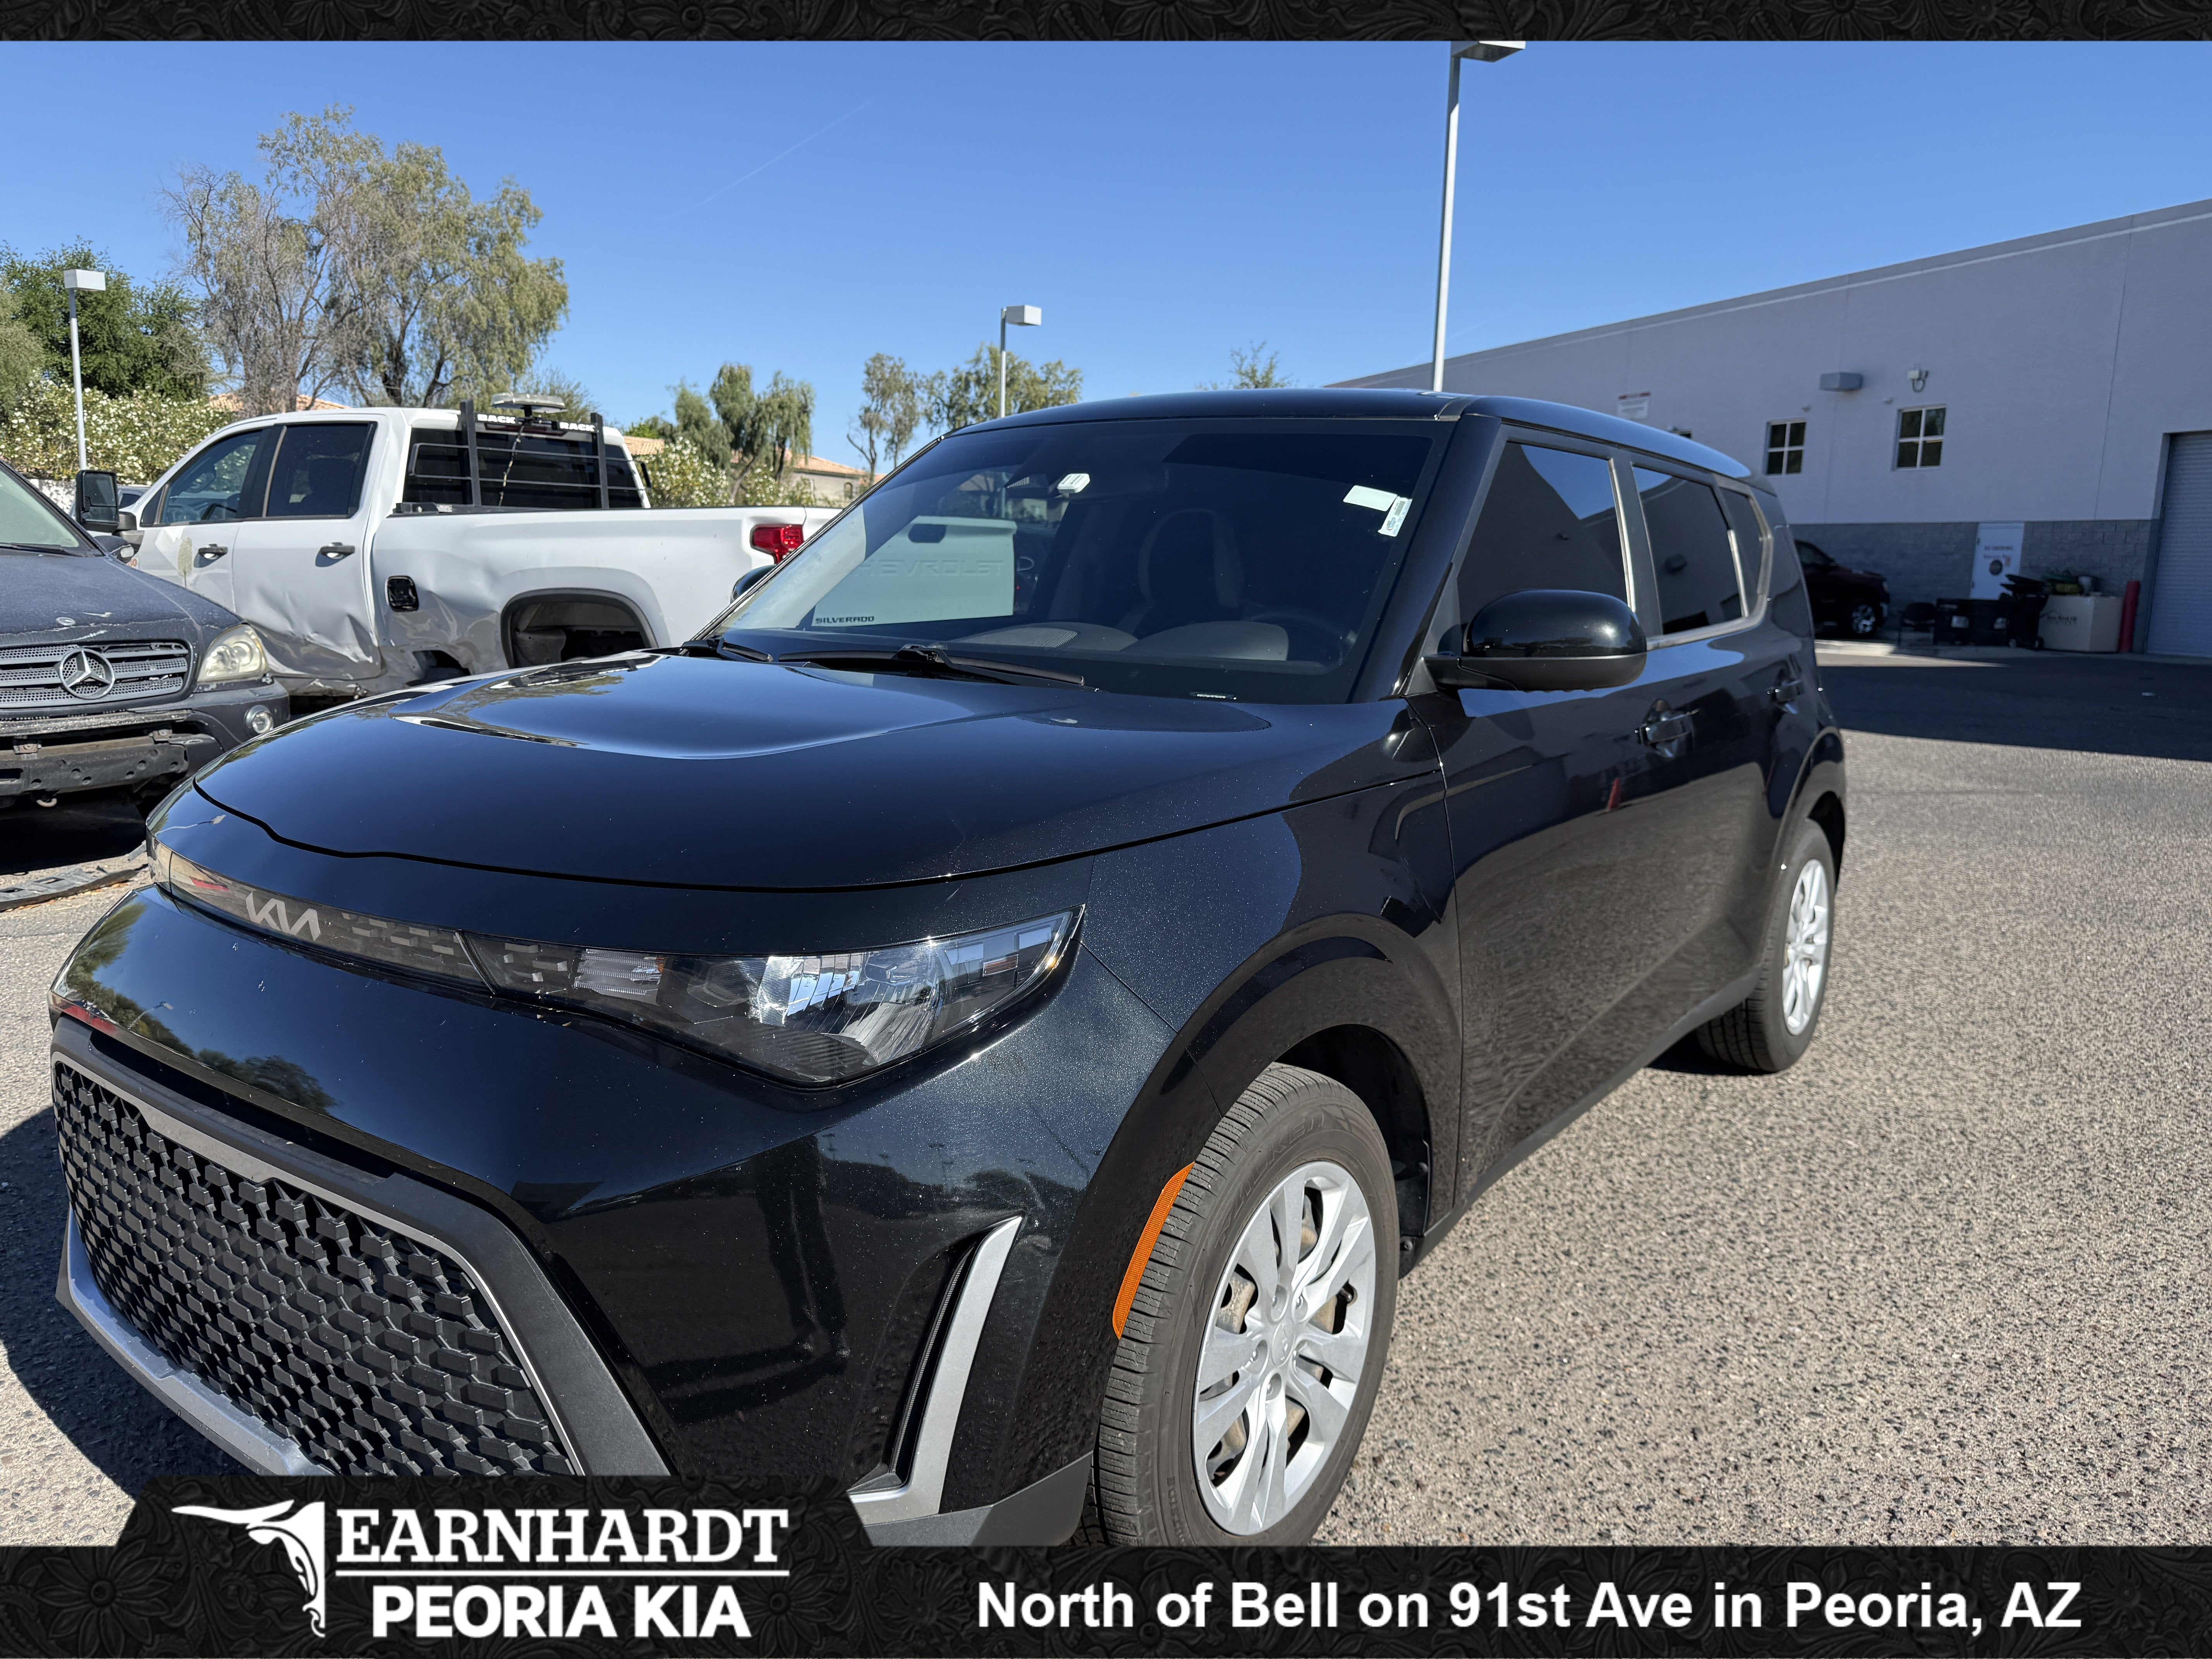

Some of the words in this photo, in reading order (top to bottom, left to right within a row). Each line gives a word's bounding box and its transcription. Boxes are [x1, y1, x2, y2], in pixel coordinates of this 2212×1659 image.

[854, 559, 1004, 577] HEVROLET
[815, 616, 874, 624] SILVERADO
[246, 891, 321, 940] KIA
